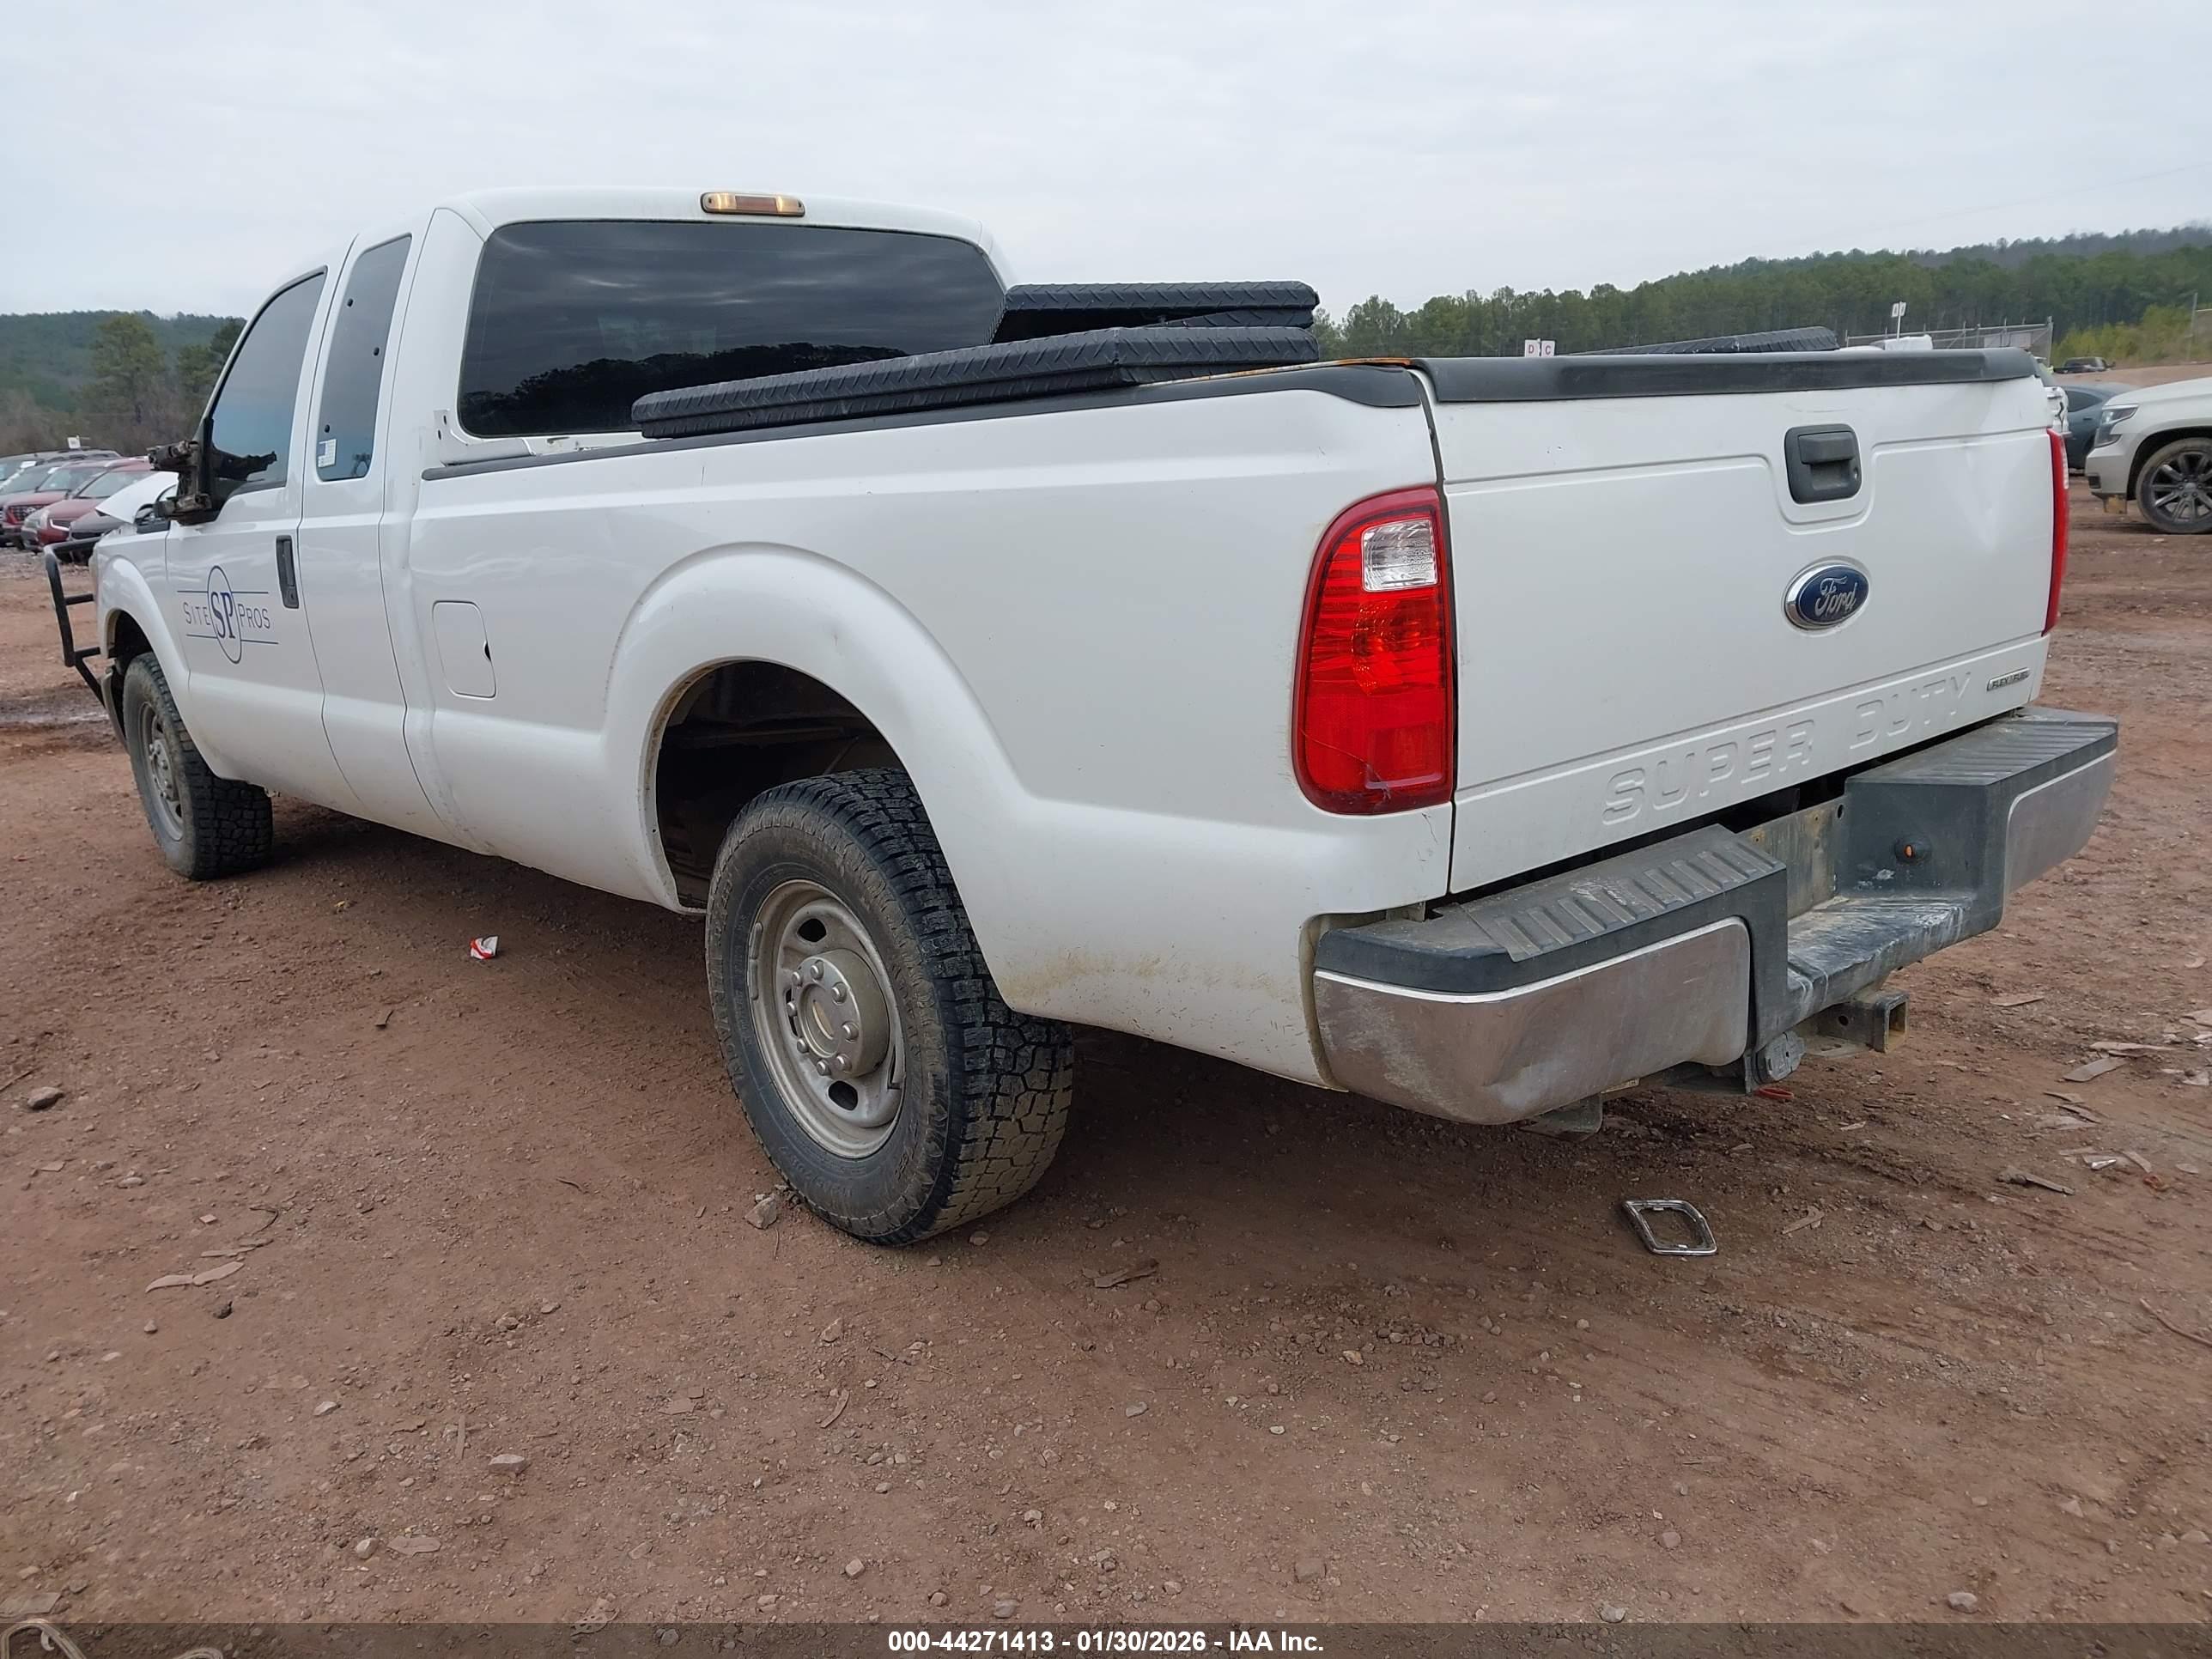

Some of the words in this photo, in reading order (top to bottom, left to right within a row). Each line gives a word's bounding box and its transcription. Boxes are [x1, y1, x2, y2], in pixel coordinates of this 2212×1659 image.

[183, 601, 210, 625] SITE
[210, 591, 236, 640] SP
[237, 603, 271, 629] PROS
[1814, 575, 1857, 617] Ford
[1602, 720, 1814, 825] SUPER
[1850, 672, 1972, 750] DUTY
